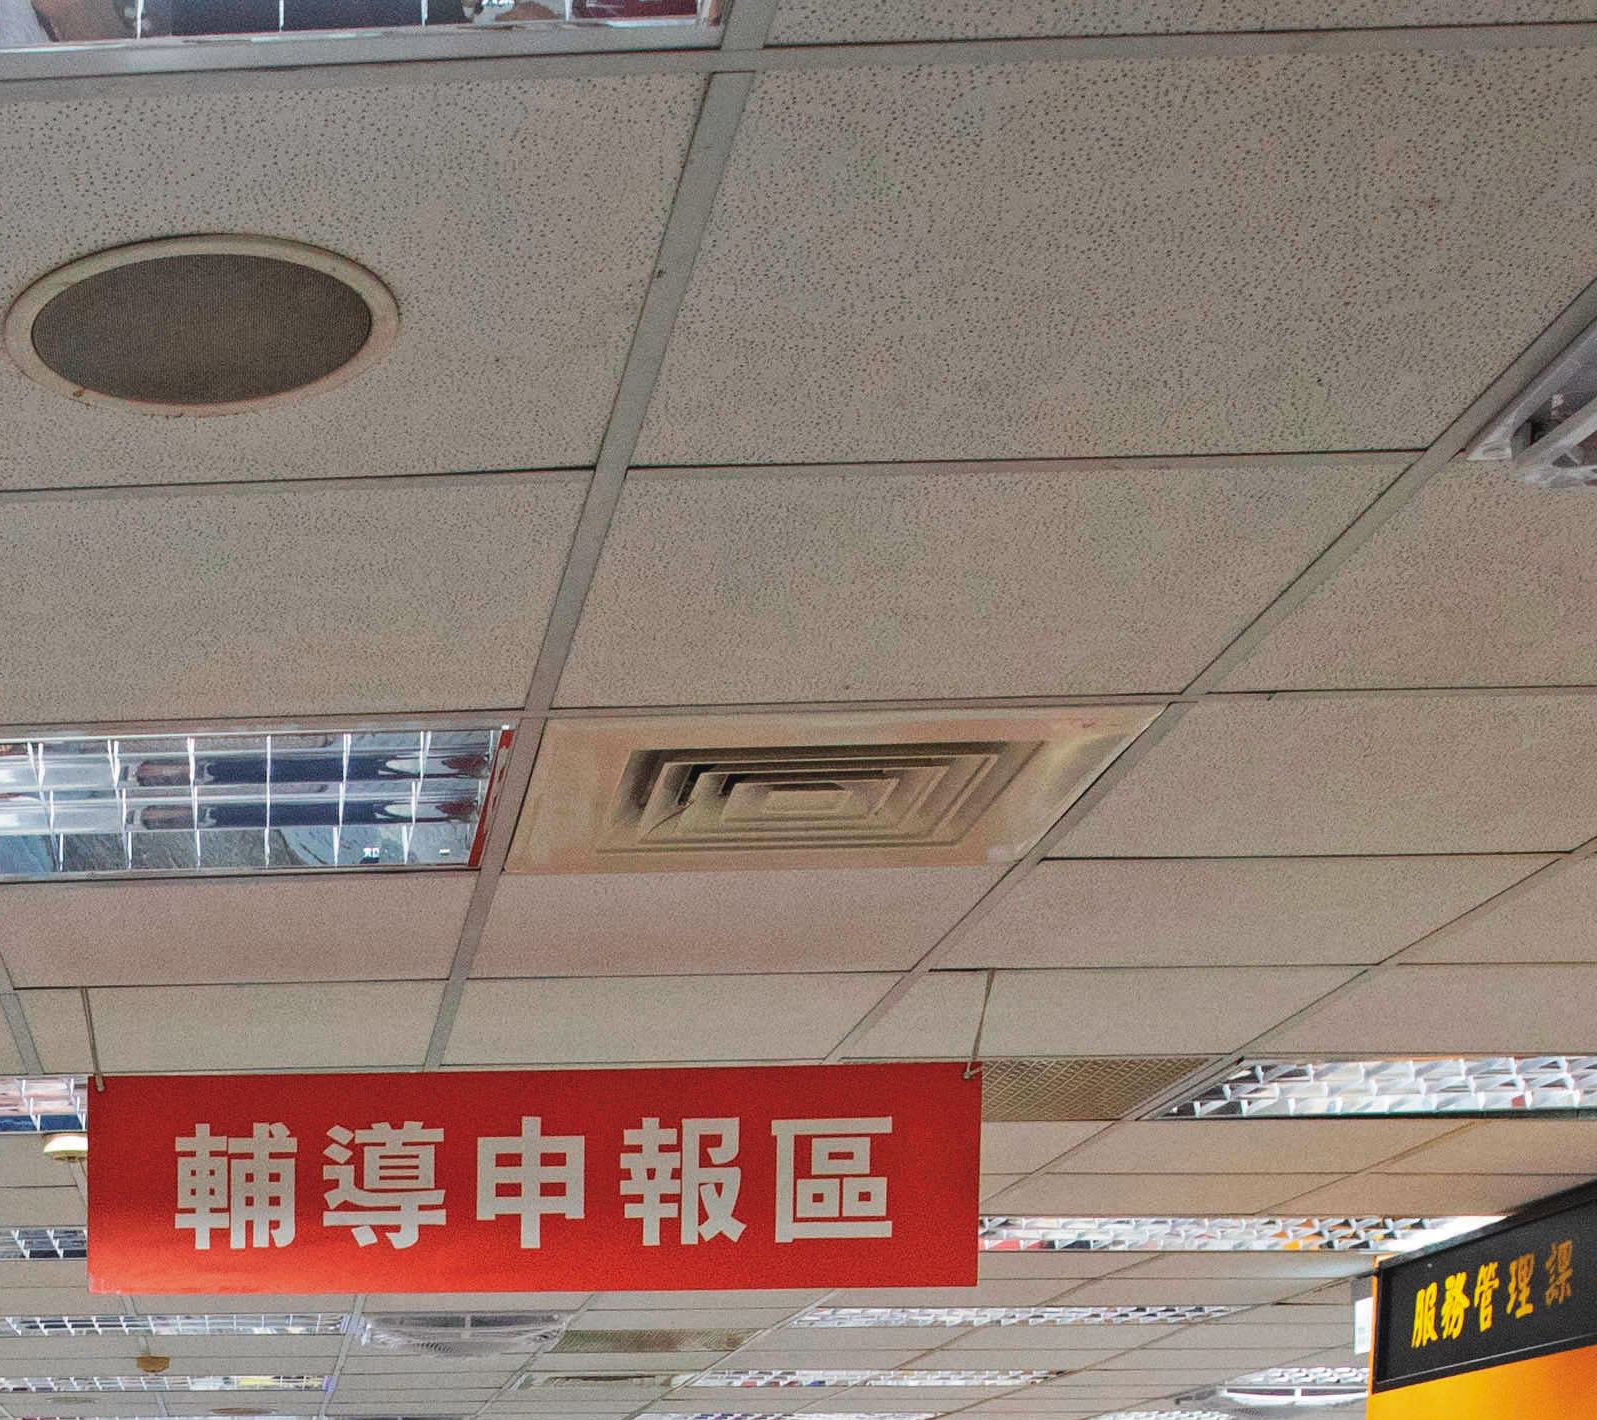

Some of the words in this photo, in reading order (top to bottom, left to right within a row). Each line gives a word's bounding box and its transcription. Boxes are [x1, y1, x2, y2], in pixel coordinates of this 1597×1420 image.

[174, 1115, 893, 1251] 輔導申報區
[1411, 1240, 1576, 1350] 服務管理課
